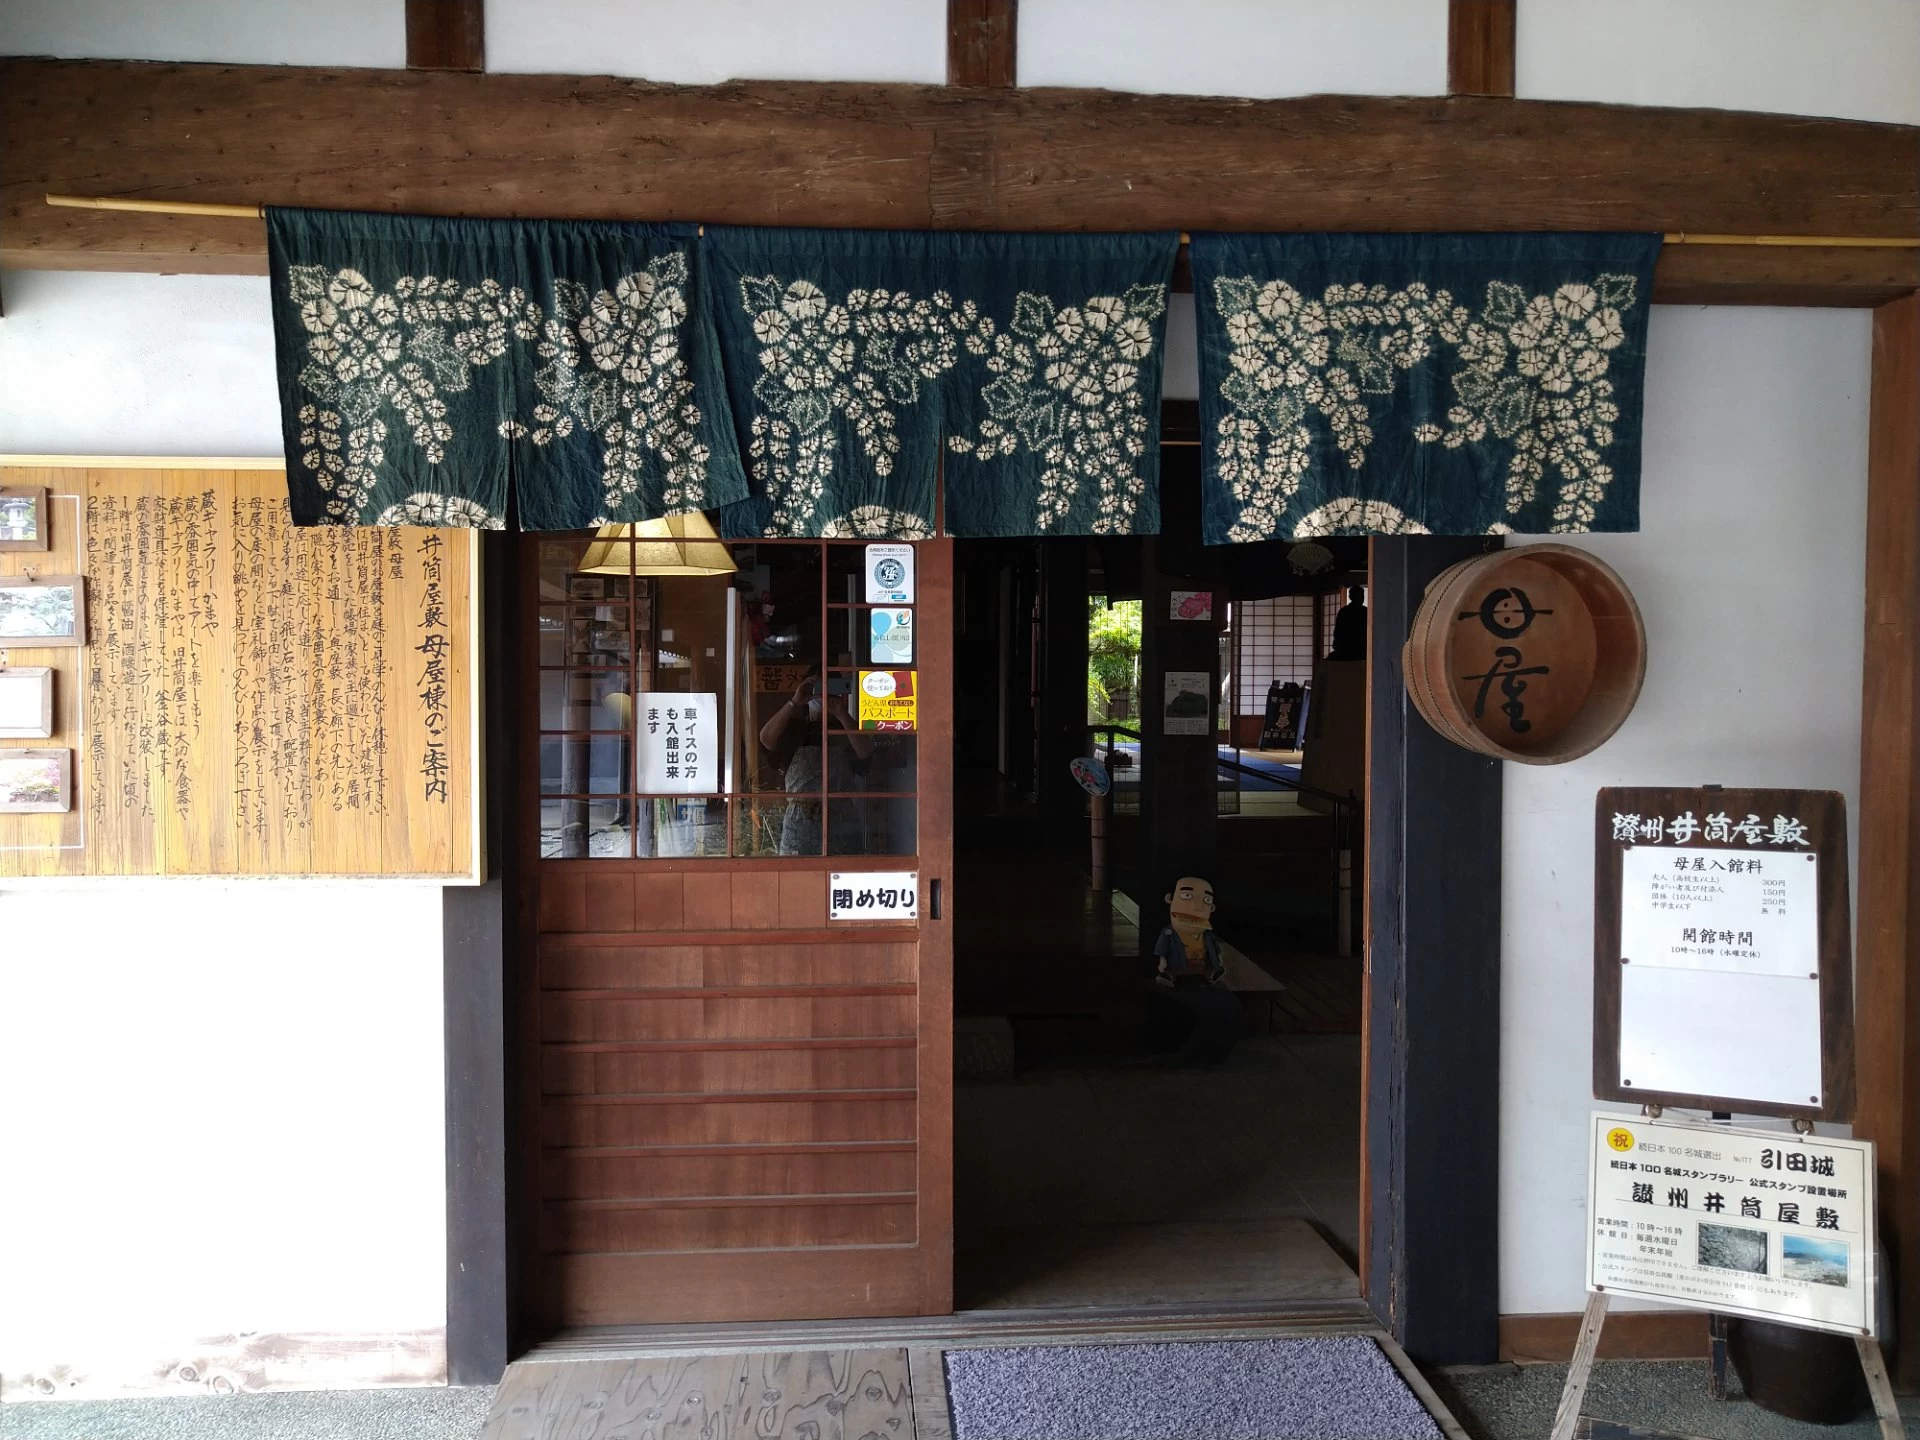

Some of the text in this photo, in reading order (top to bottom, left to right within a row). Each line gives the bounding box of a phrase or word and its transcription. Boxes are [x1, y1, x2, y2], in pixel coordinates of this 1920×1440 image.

[415, 527, 449, 803] 井筒屋敷母屋棟のご案内
[861, 699, 887, 708] うどん県
[647, 706, 661, 735] ます
[862, 707, 915, 719] パスポート
[877, 721, 913, 731] クーポン
[665, 706, 680, 780] も入館出来
[683, 706, 699, 780] 車イスの方
[1673, 856, 1764, 875] 母屋入館料
[1762, 879, 1786, 887] 300円
[832, 888, 916, 910] 閉め切り
[1762, 889, 1786, 897] 150円
[1651, 901, 1692, 911] 中学生以下
[1762, 898, 1786, 906] 250円
[1682, 927, 1754, 947] 開館時間
[1612, 1132, 1629, 1149] 祝
[1760, 1148, 1836, 1177] 引田城
[1639, 1245, 1673, 1258] 年末年始
